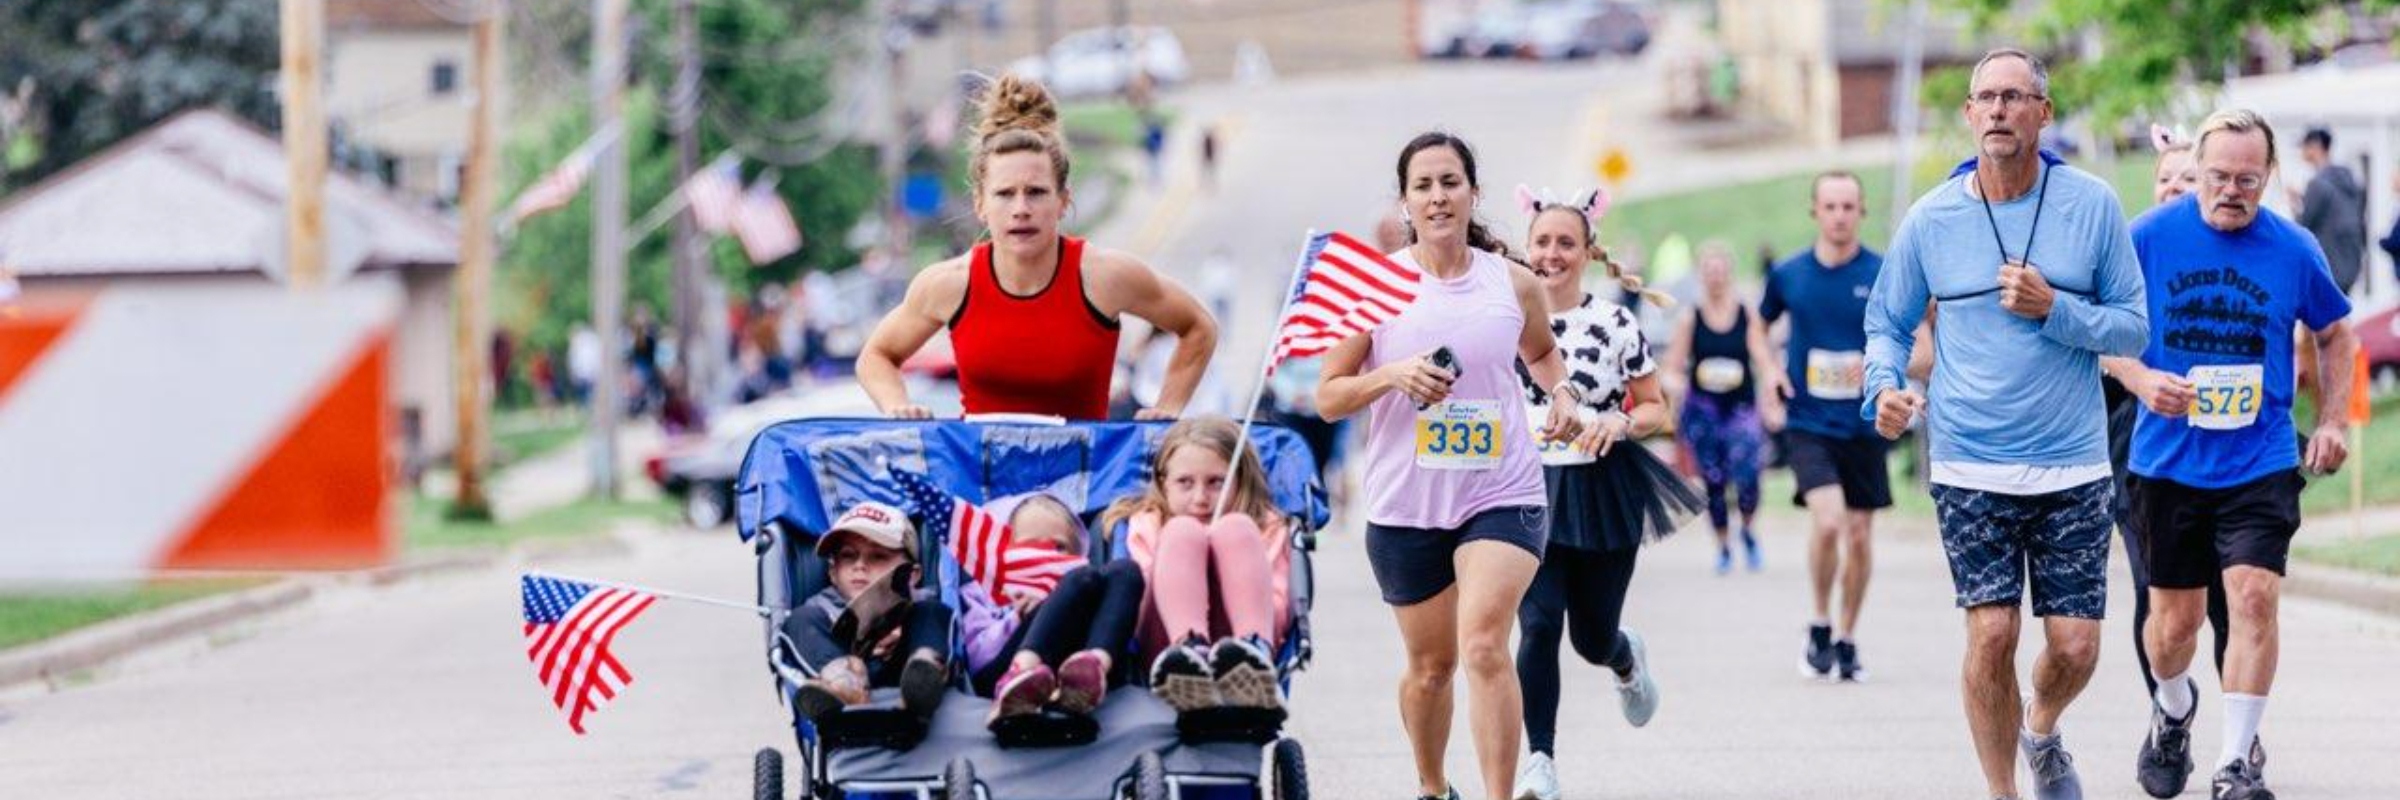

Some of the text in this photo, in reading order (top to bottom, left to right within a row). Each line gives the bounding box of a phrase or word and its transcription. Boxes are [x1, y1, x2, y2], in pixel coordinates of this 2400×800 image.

[2167, 268, 2219, 296] Lions
[2198, 386, 2254, 414] 572
[1428, 422, 1492, 454] 333
